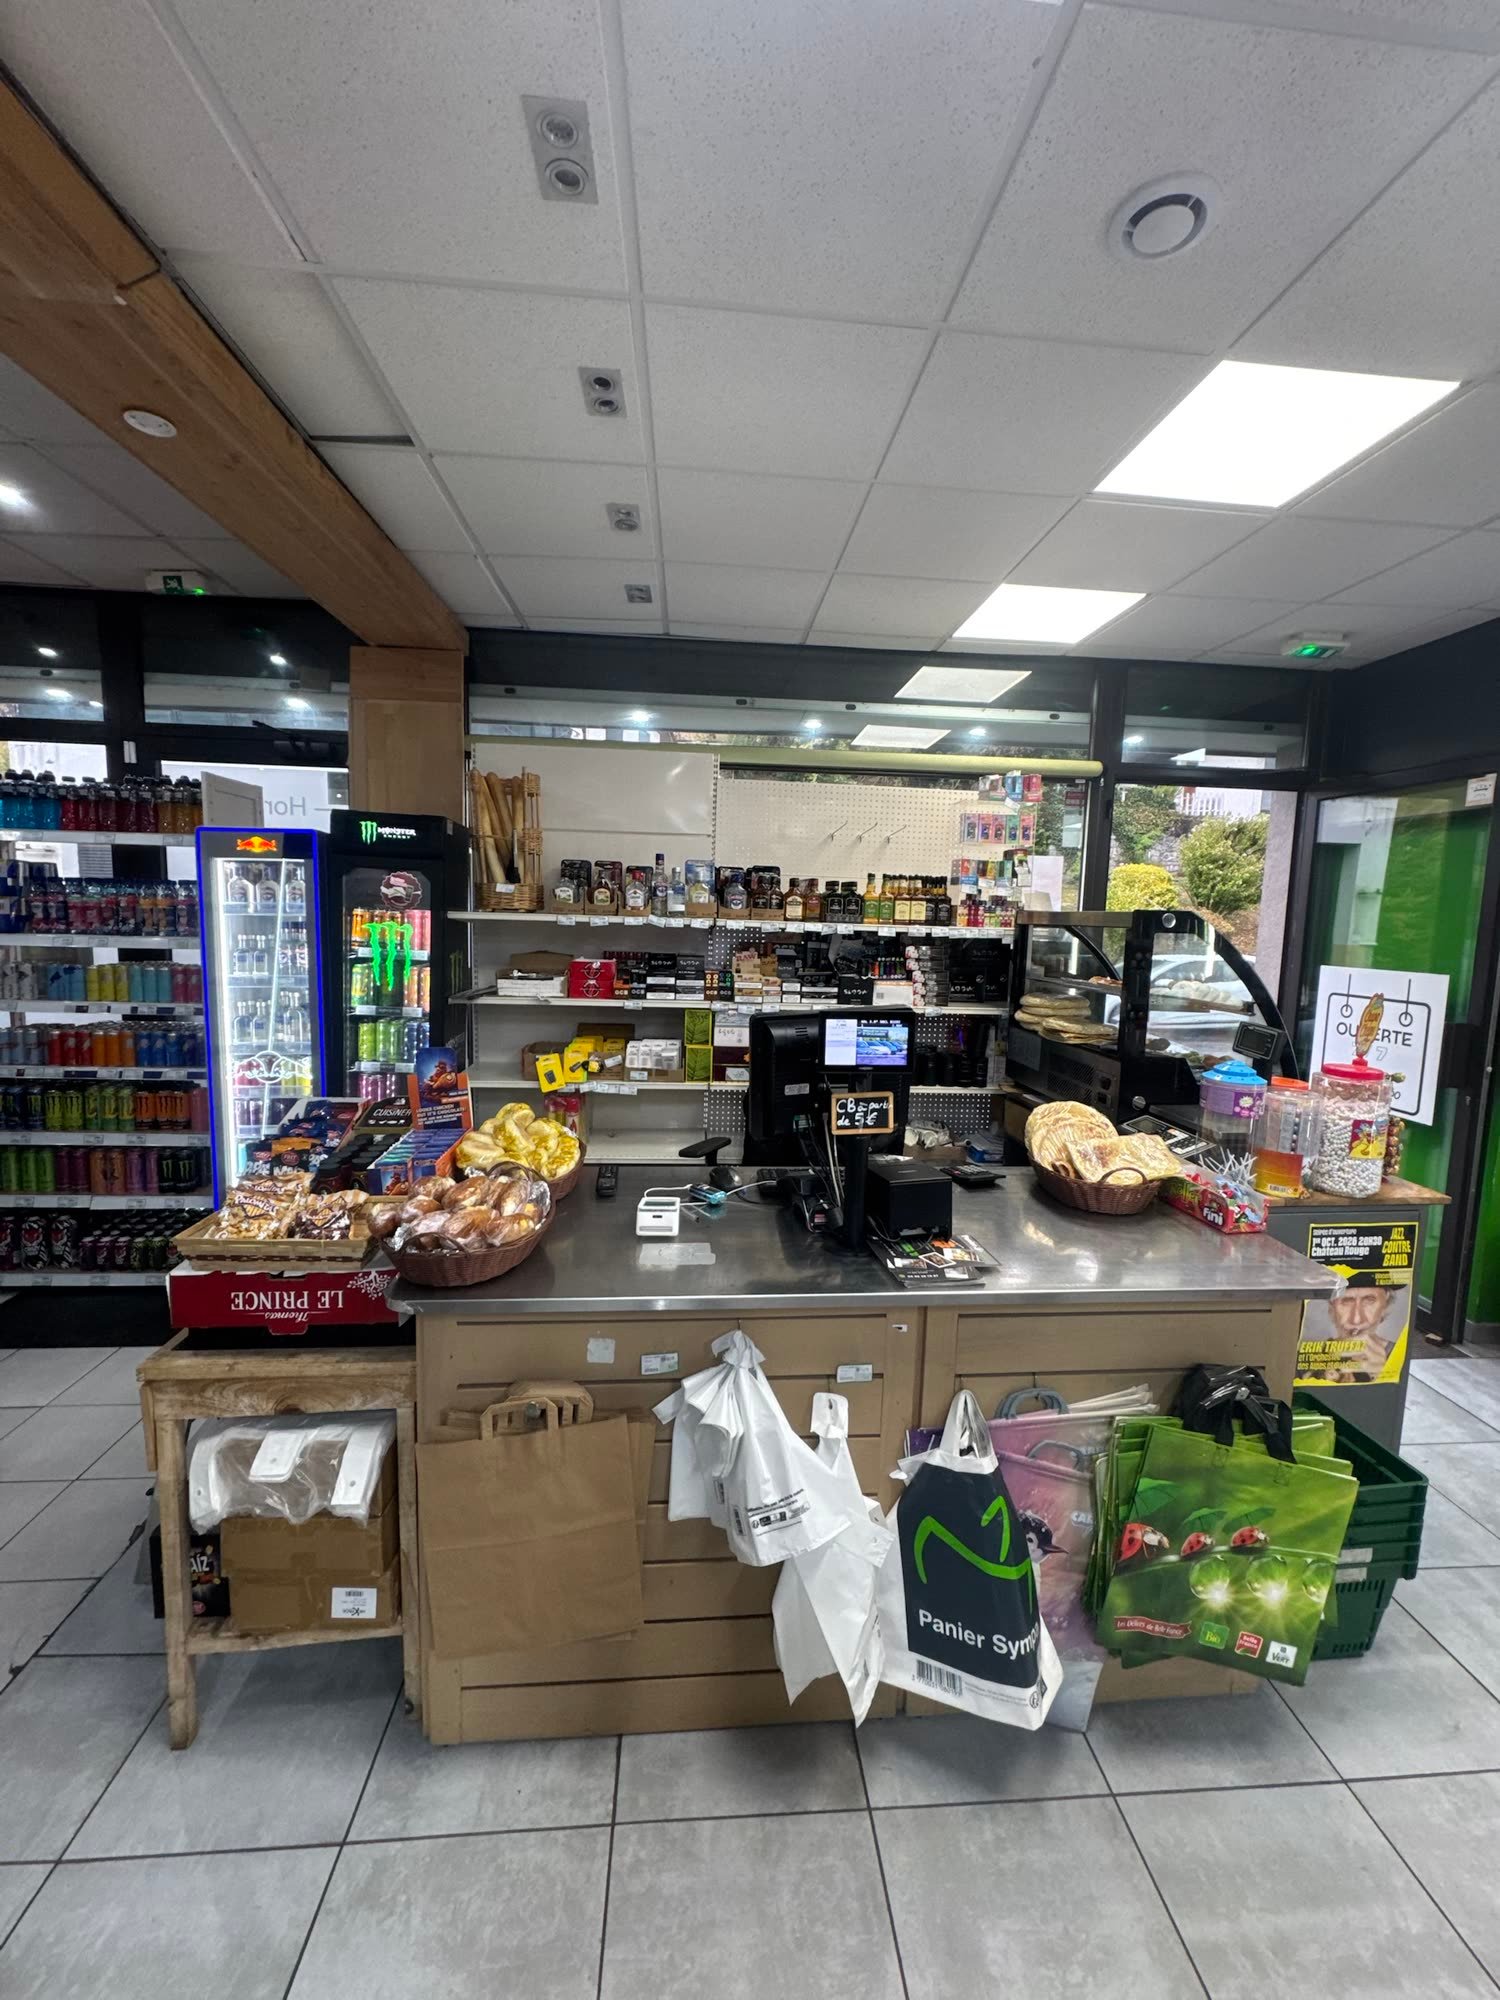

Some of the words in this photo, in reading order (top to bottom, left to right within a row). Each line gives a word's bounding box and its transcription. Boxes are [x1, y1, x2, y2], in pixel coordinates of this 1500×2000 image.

[1336, 1022, 1414, 1047] OUERTE
[836, 1098, 856, 1113] CB
[836, 1115, 851, 1126] de
[855, 1112, 864, 1126] 5
[1390, 1227, 1405, 1240] JAZZ
[1321, 1237, 1337, 1247] OCT.
[1382, 1240, 1411, 1253] CONTRE
[1344, 1246, 1370, 1256] Rouge
[1382, 1254, 1409, 1267] BAND
[231, 1291, 309, 1310] PRINCE
[317, 1290, 344, 1309] LE
[264, 1311, 310, 1323] Thomas
[1299, 1341, 1324, 1353] ERIK
[918, 1608, 985, 1649] Panier
